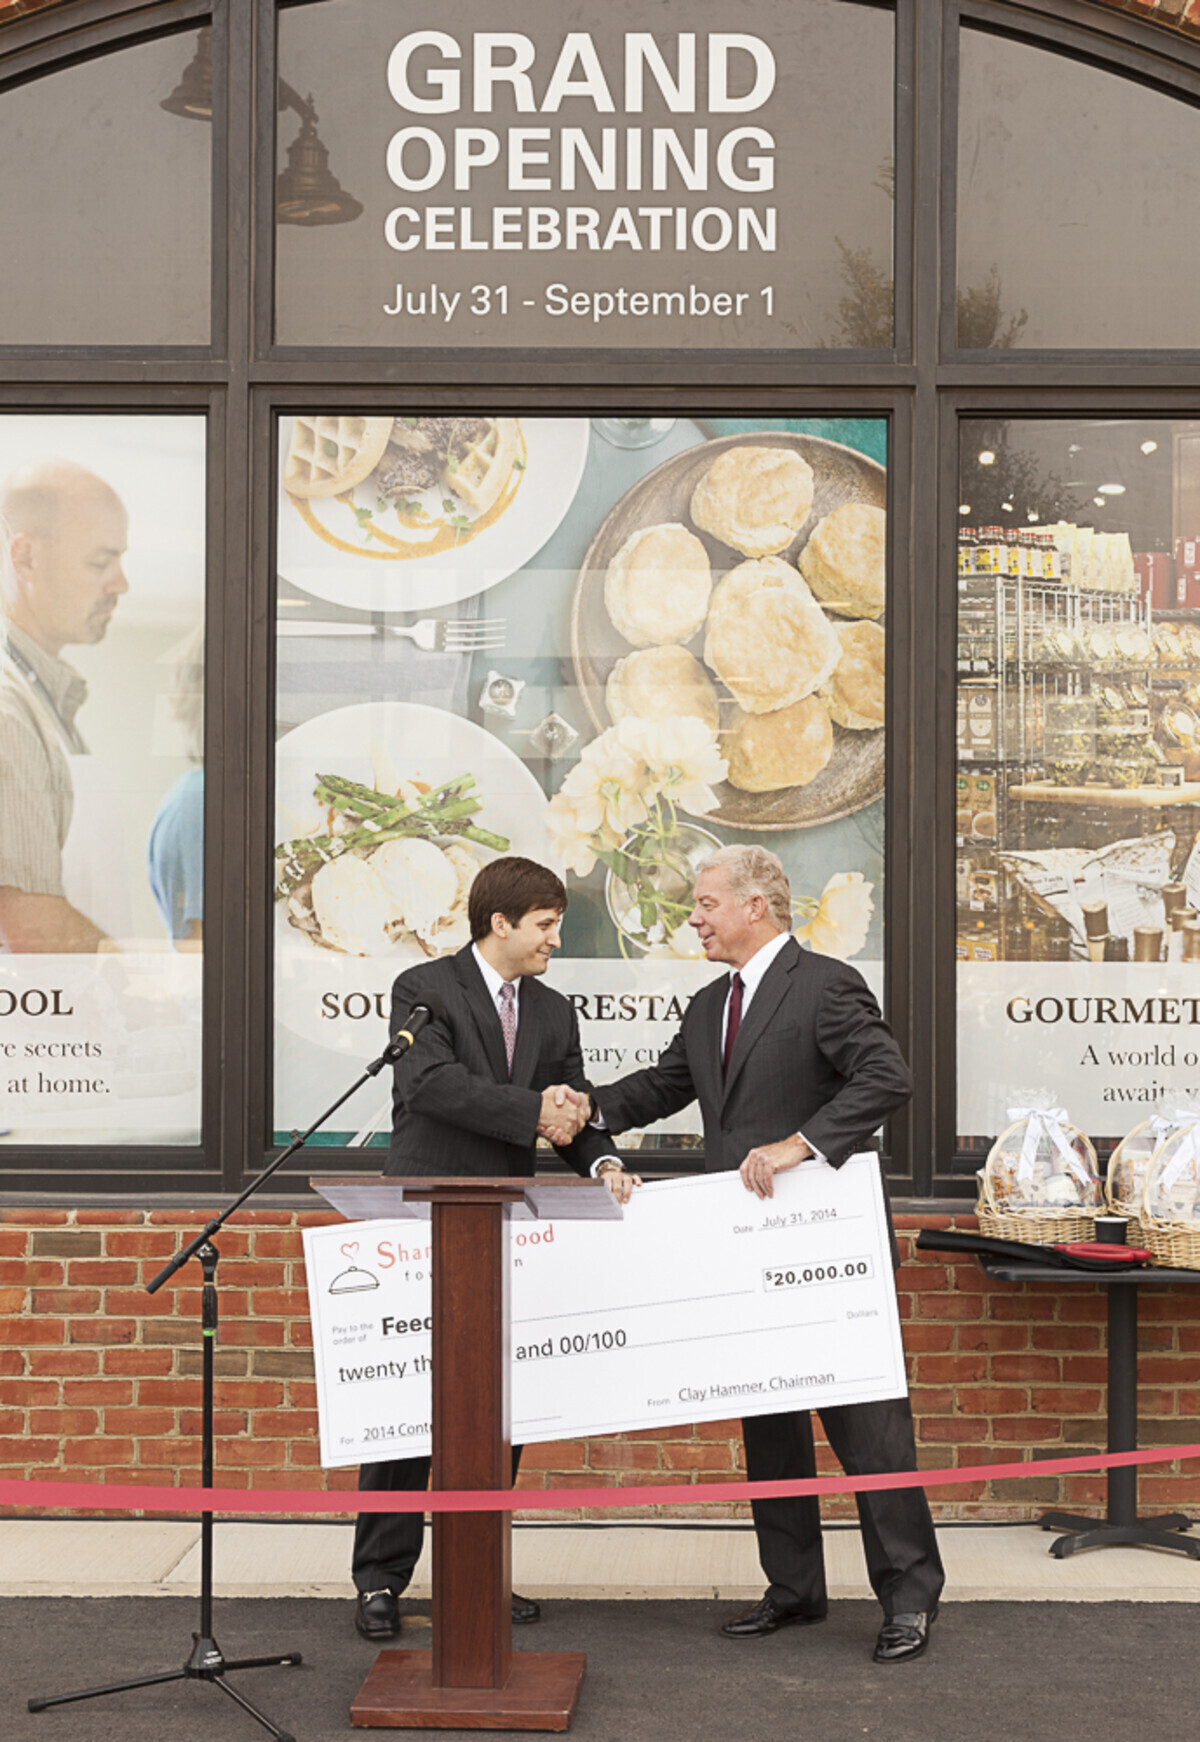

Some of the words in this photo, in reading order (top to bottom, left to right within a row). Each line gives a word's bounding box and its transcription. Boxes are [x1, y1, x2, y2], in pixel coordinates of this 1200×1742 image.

[387, 30, 776, 114] GRAND
[386, 126, 776, 192] OPENING
[384, 206, 777, 251] CELEBRATION
[383, 284, 461, 322] July
[470, 285, 508, 315] 31
[545, 284, 749, 322] September
[760, 286, 773, 315] 1
[567, 994, 694, 1021] RESTA
[1006, 997, 1200, 1024] GOURMET
[24, 1040, 102, 1058] secrets
[1081, 1045, 1100, 1065] A
[1108, 1045, 1175, 1066] world
[8, 1076, 28, 1093] at
[38, 1072, 110, 1093] home.
[1103, 1080, 1175, 1101] await
[733, 1224, 754, 1234] Date
[762, 1216, 786, 1228] July
[790, 1212, 808, 1224] 31,
[811, 1208, 837, 1221] 2014
[511, 1224, 554, 1246] ood
[766, 1262, 867, 1286] $20,000.00
[360, 1322, 374, 1331] the
[846, 1309, 878, 1320] Dollars
[339, 1361, 407, 1382] twenty
[516, 1337, 553, 1359] and
[560, 1330, 627, 1354] 00/100
[648, 1398, 671, 1407] From
[679, 1387, 706, 1401] Clay
[710, 1380, 766, 1398] Hamner,
[769, 1372, 835, 1390] Chairman
[340, 1437, 354, 1445] For
[364, 1426, 394, 1441] 2014
